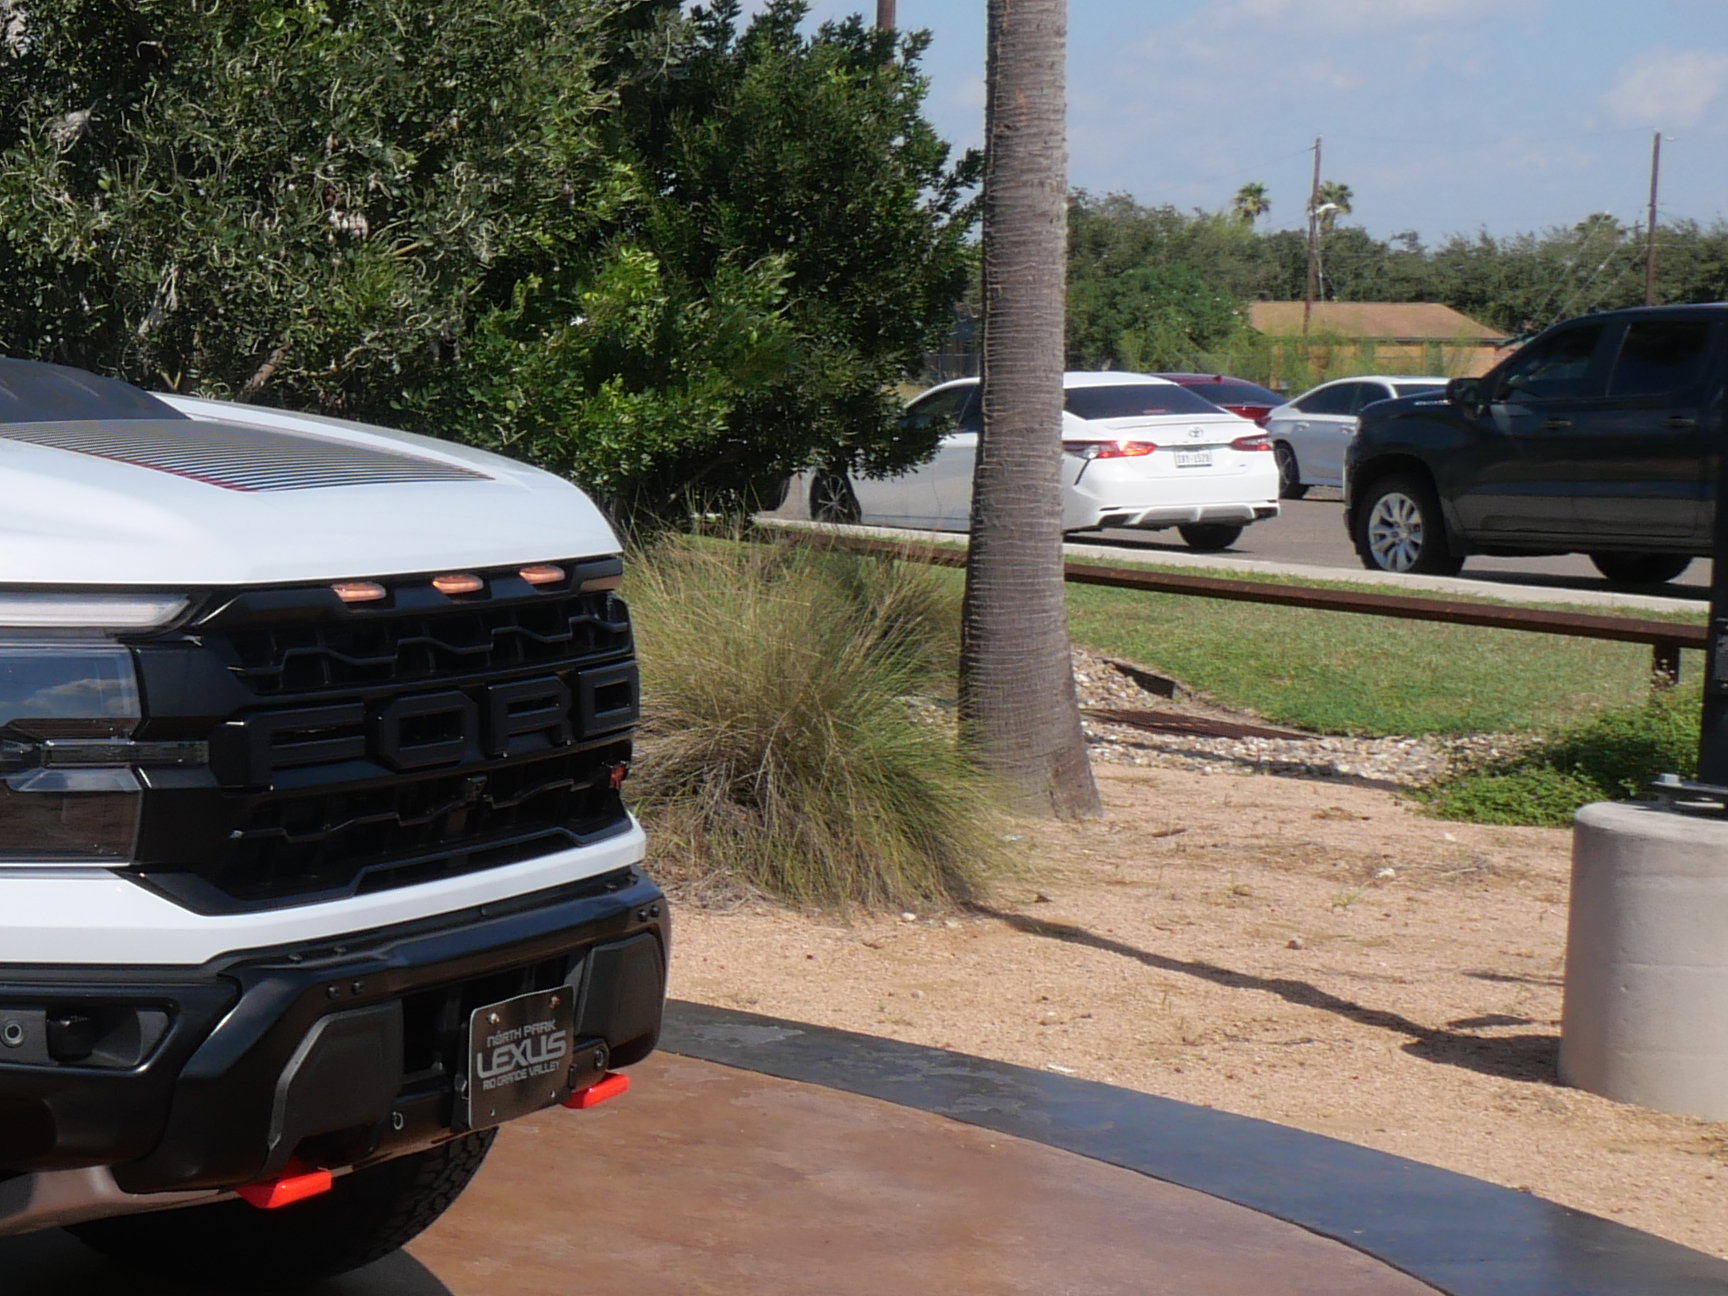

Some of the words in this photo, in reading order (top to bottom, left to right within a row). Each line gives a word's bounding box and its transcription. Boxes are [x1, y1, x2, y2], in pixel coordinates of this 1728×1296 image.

[212, 659, 640, 790] FORD
[524, 1019, 556, 1036] PARK
[477, 1030, 566, 1078] LEXUS
[483, 1078, 496, 1090] RIO
[497, 1068, 528, 1087] GRANDE
[528, 1060, 560, 1077] VALLEY
